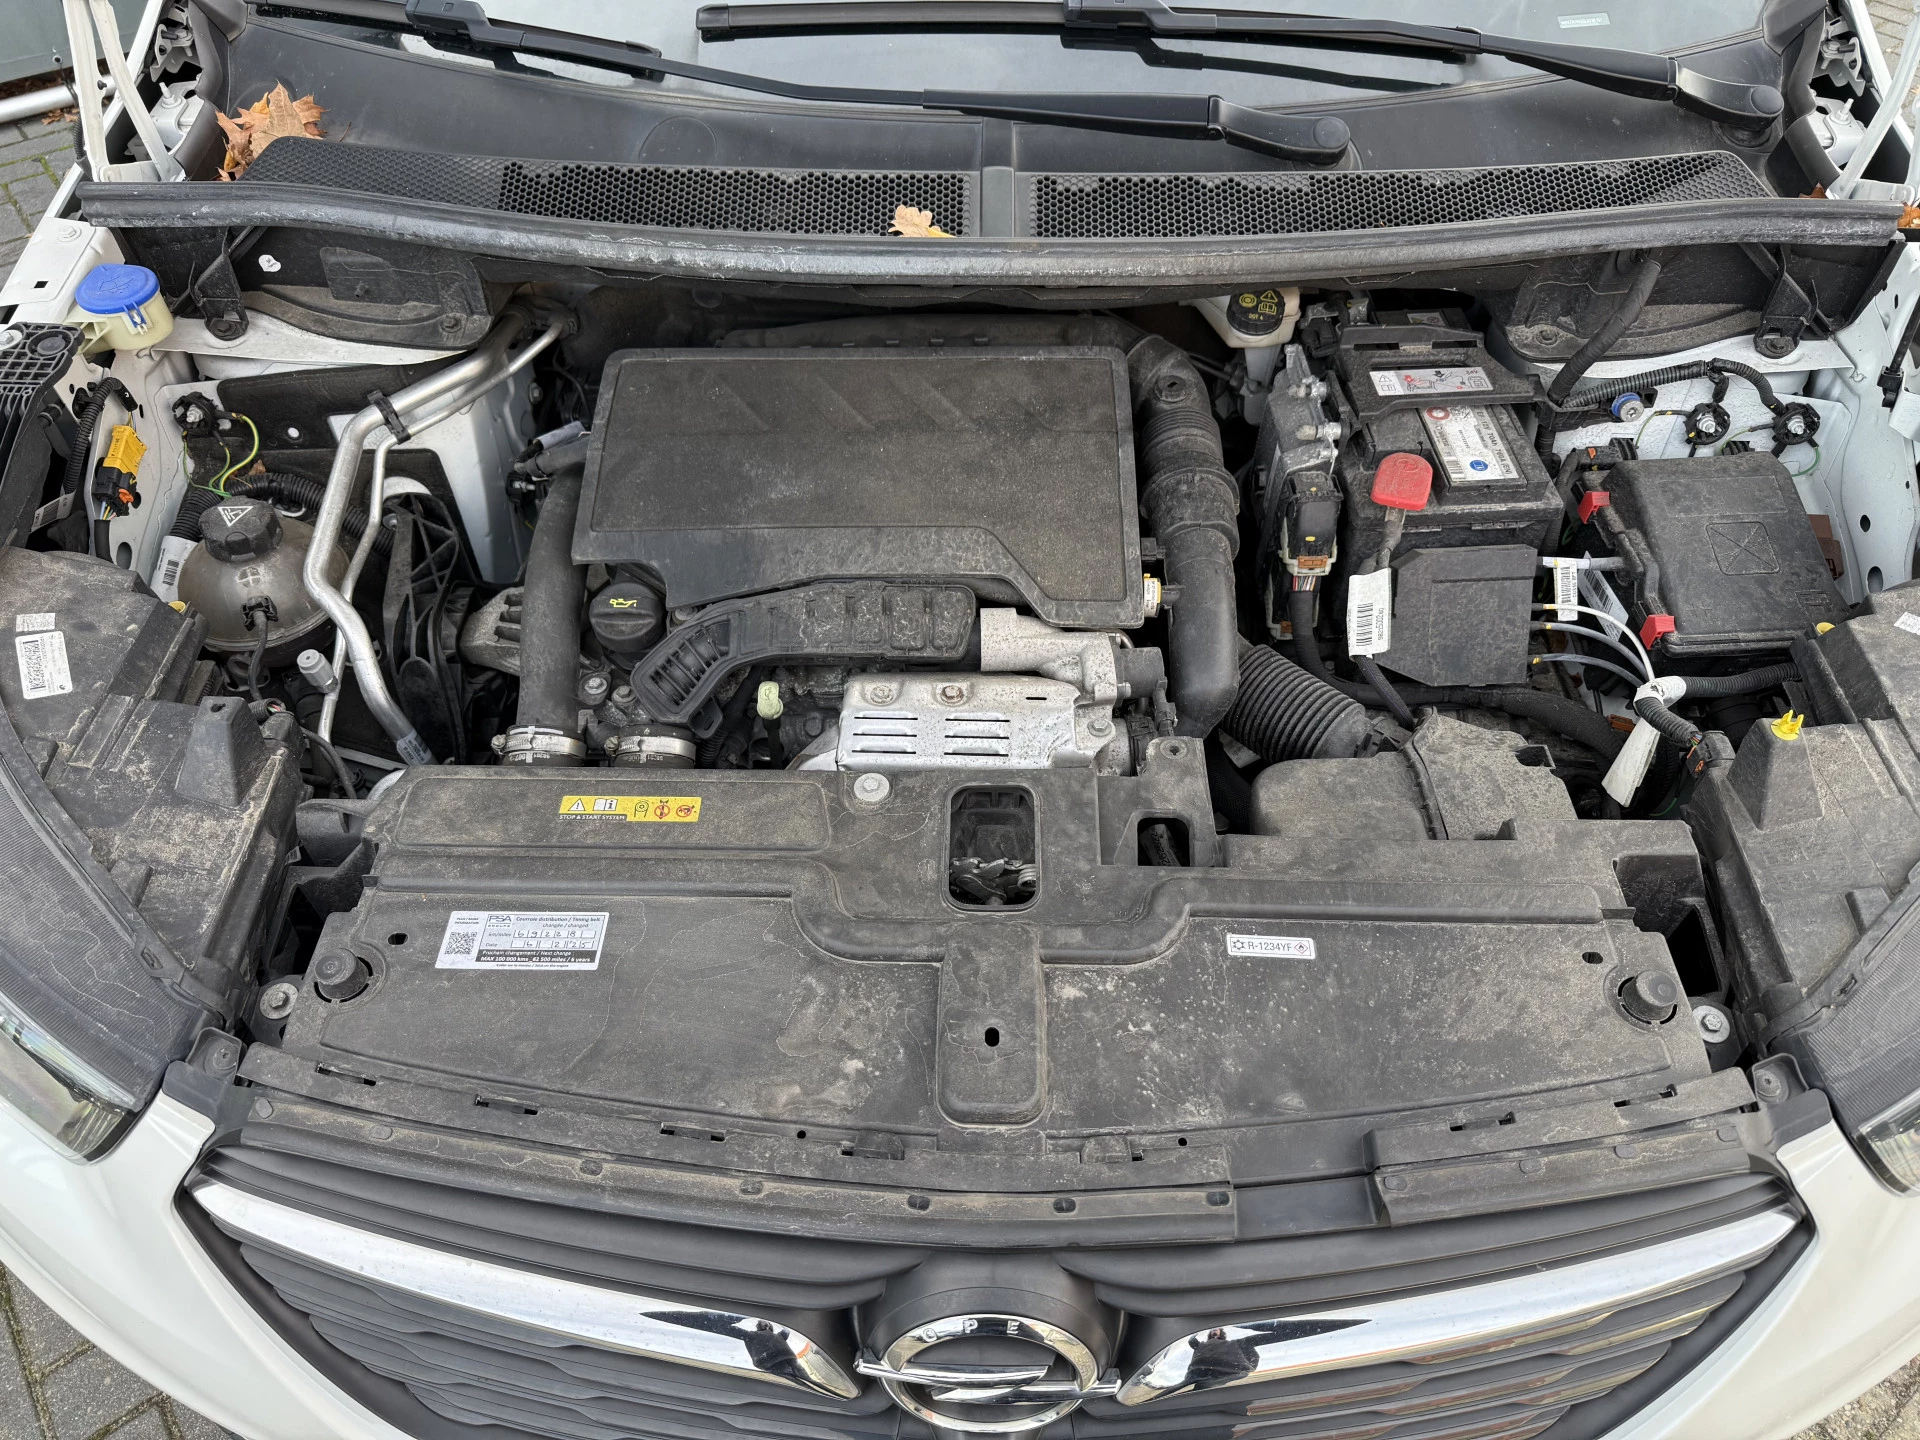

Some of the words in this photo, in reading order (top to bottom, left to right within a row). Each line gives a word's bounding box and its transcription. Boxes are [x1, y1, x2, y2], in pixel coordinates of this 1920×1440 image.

[489, 915, 512, 923] PSA
[1247, 941, 1292, 951] R-1234YF
[922, 1318, 1054, 1345] OPEL
